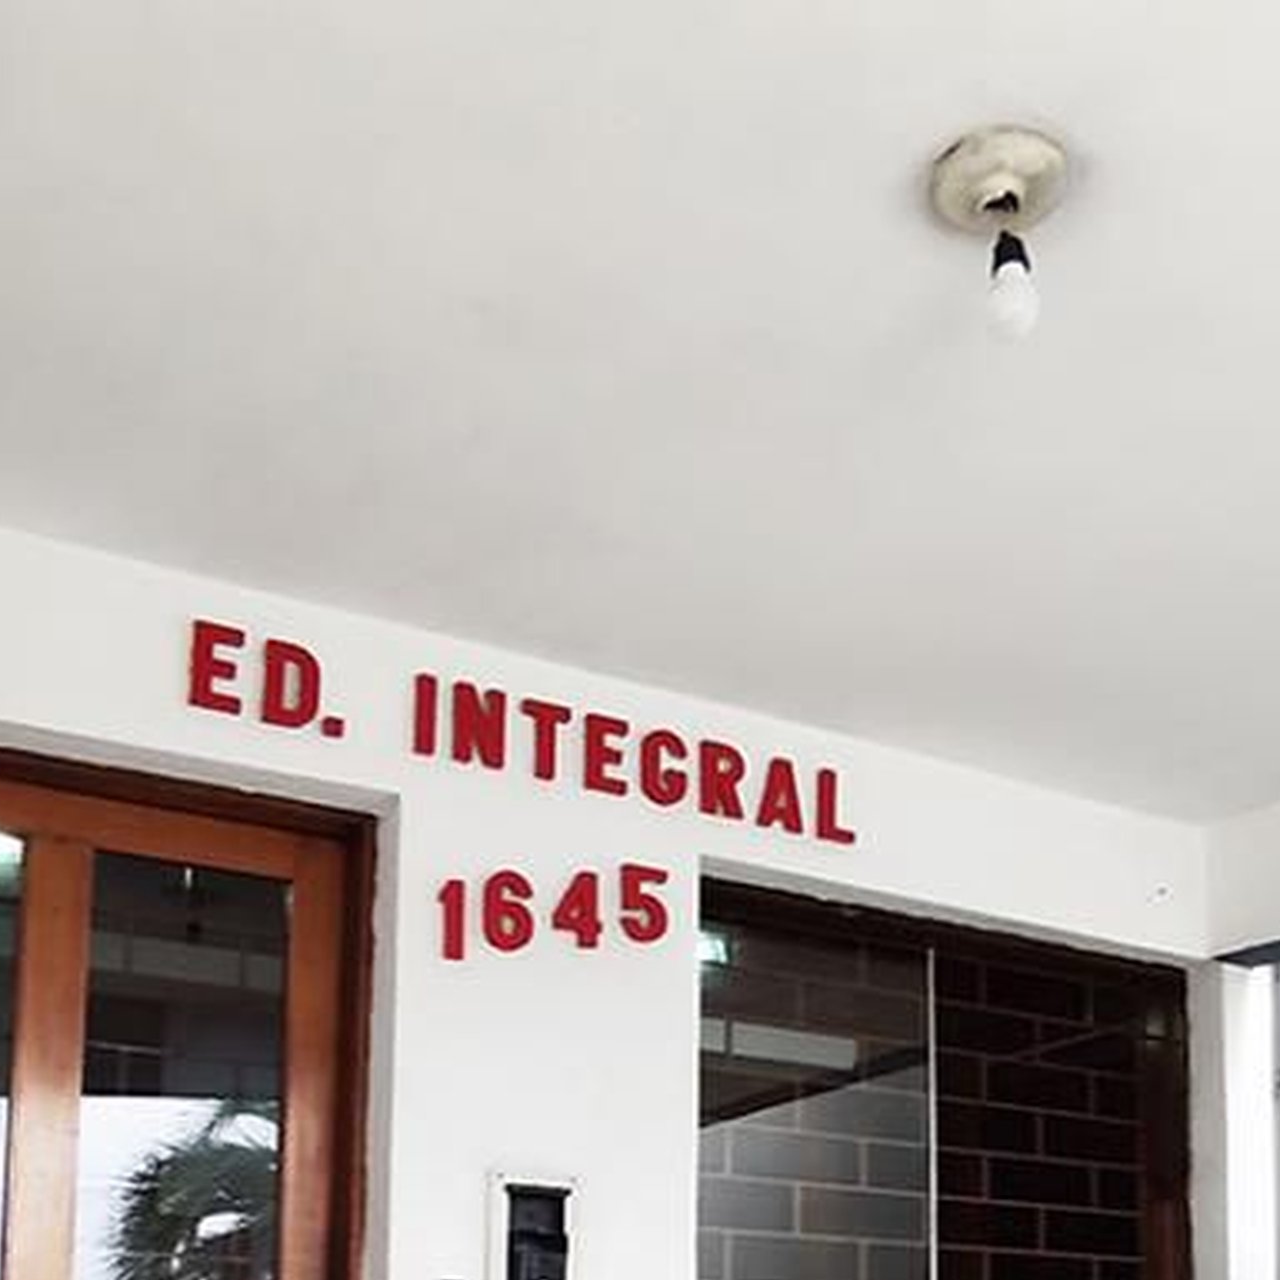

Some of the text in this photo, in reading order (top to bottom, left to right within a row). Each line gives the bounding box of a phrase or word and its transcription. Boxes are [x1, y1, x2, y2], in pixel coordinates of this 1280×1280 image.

[188, 619, 856, 845] ED. INTEGRAL
[437, 864, 669, 962] 1645
